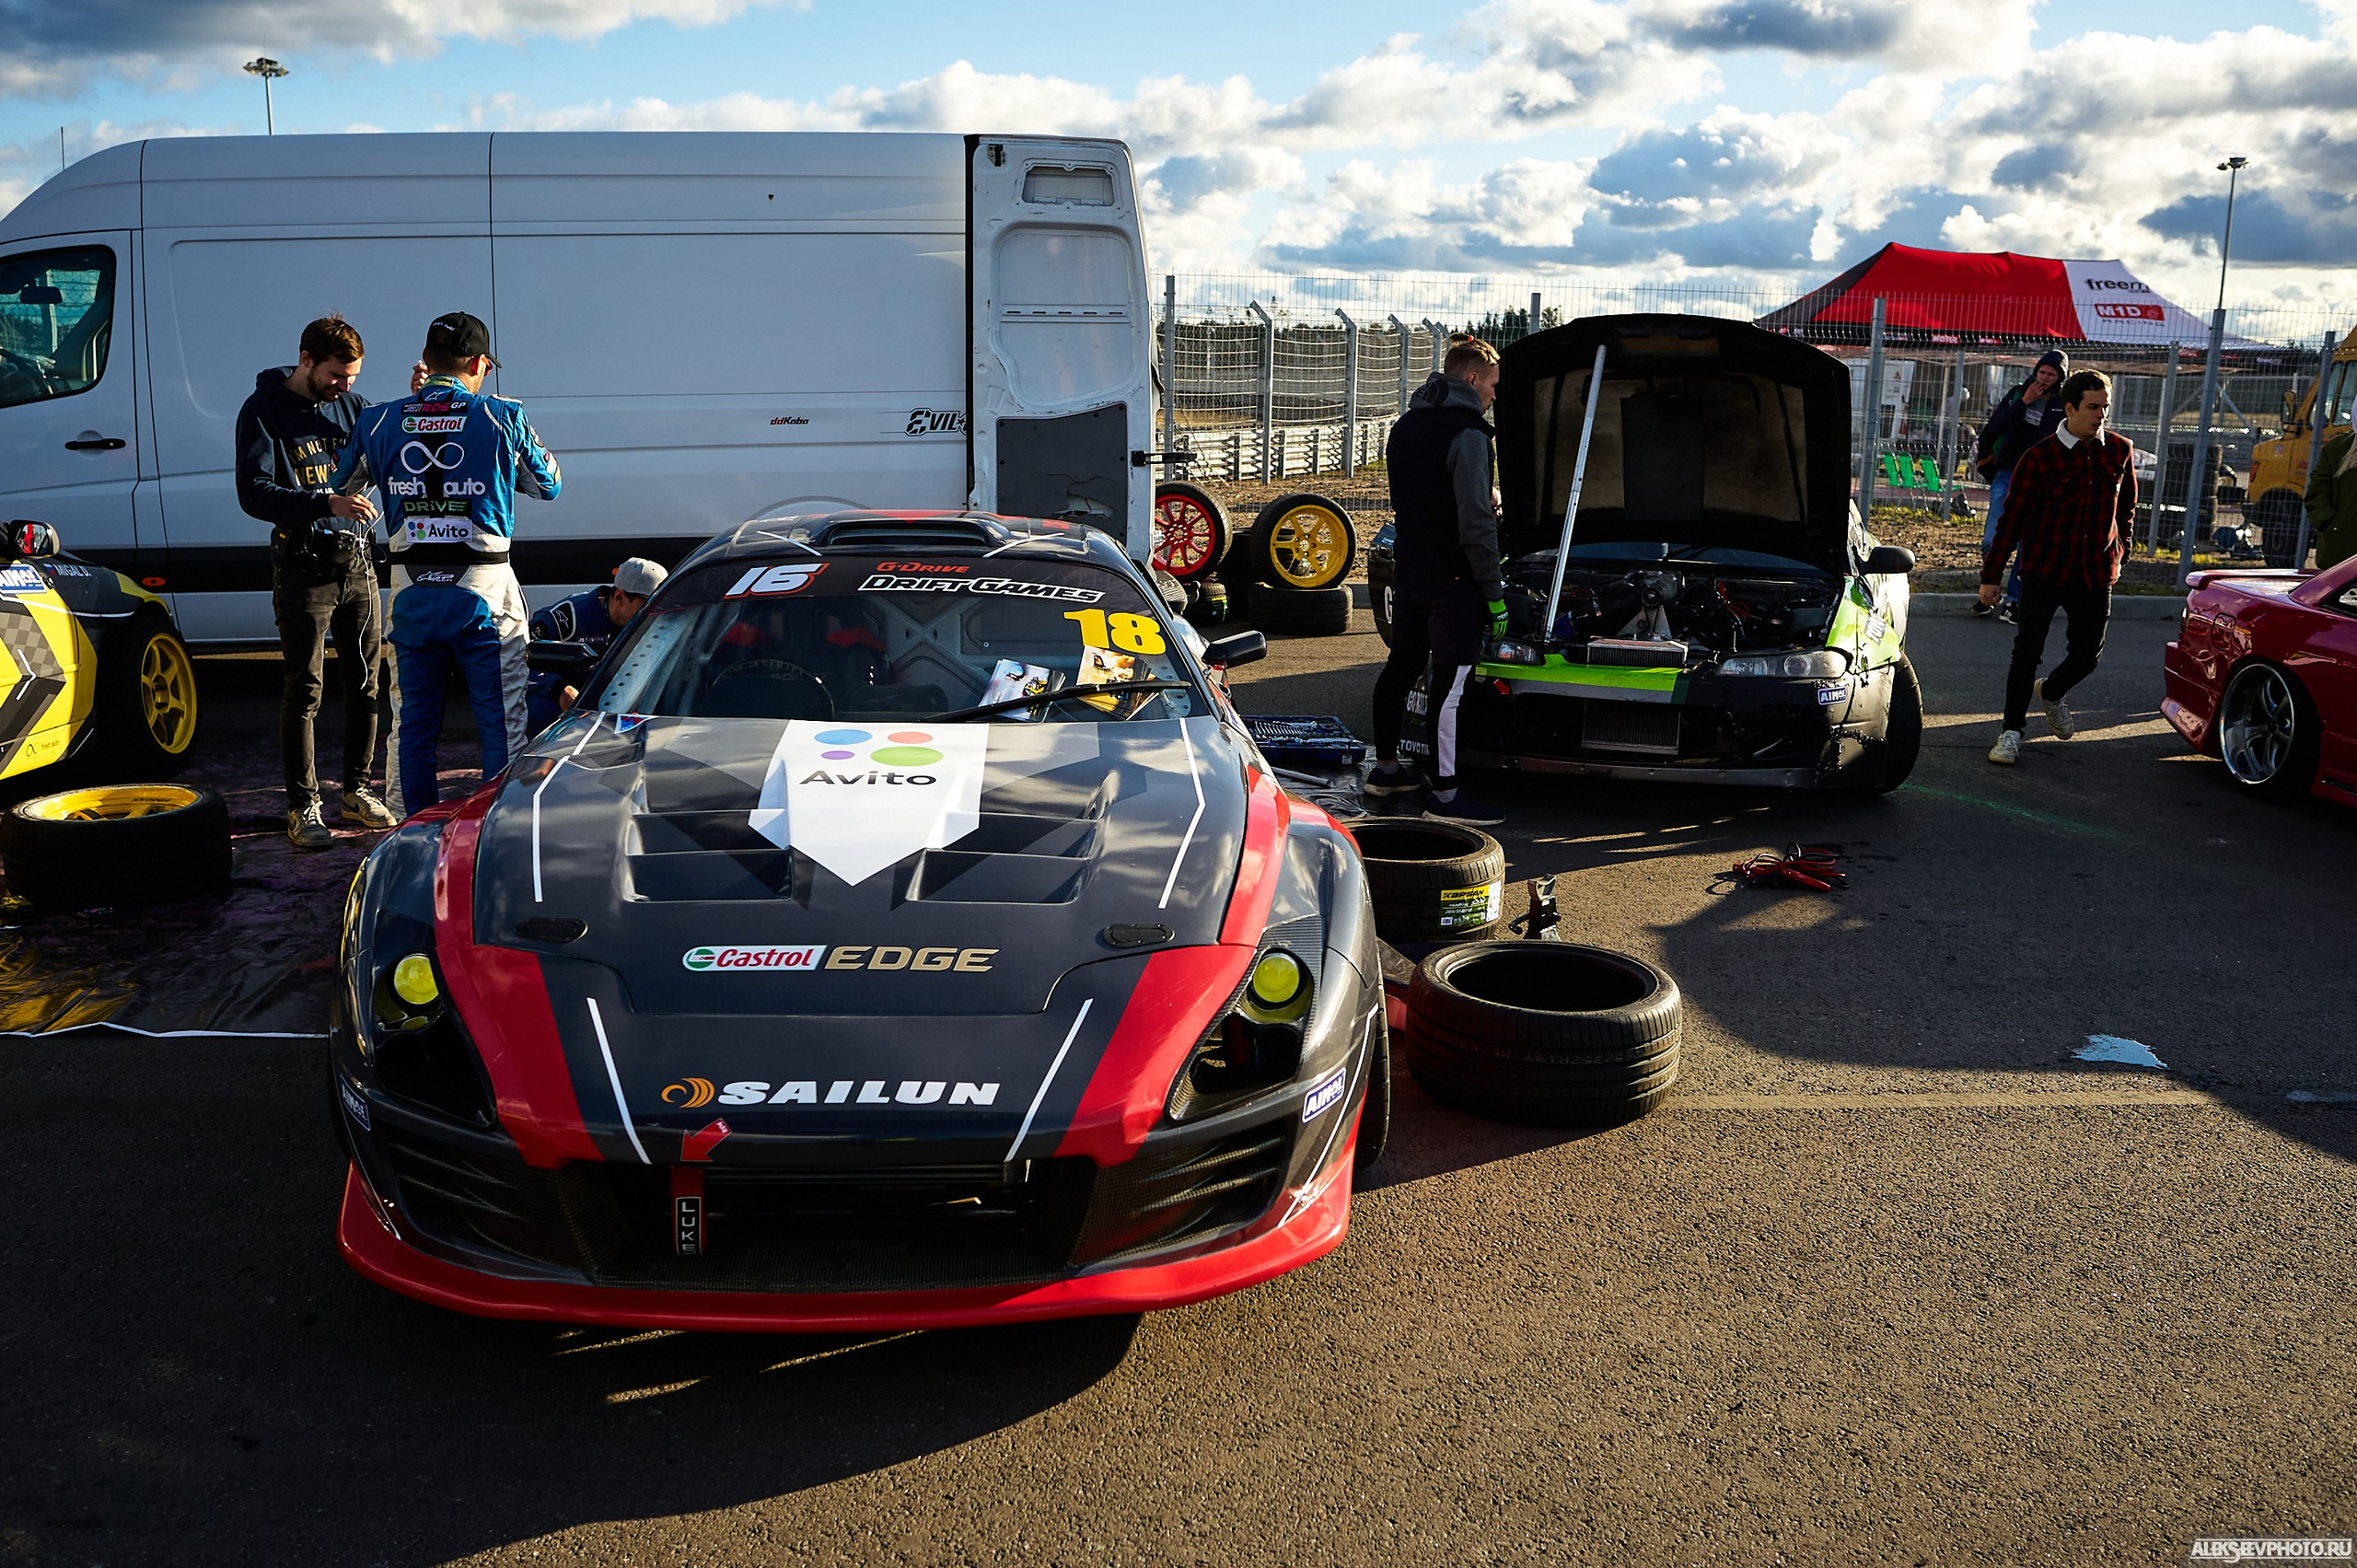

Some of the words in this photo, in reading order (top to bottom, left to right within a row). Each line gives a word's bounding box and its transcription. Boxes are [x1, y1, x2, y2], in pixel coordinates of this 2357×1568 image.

[417, 417, 462, 432] Castrol
[388, 476, 426, 496] fresh
[443, 478, 486, 496] auto
[428, 524, 469, 538] Avito
[53, 563, 85, 576] MIGAL
[723, 563, 829, 599] 16
[857, 575, 973, 593] DRIFT
[970, 576, 1108, 604] GAMES
[1063, 608, 1167, 655] 18
[798, 770, 937, 785] Avito
[716, 948, 815, 968] Castrol
[824, 946, 1000, 972] EDGE
[717, 1080, 1001, 1105] SAILUN
